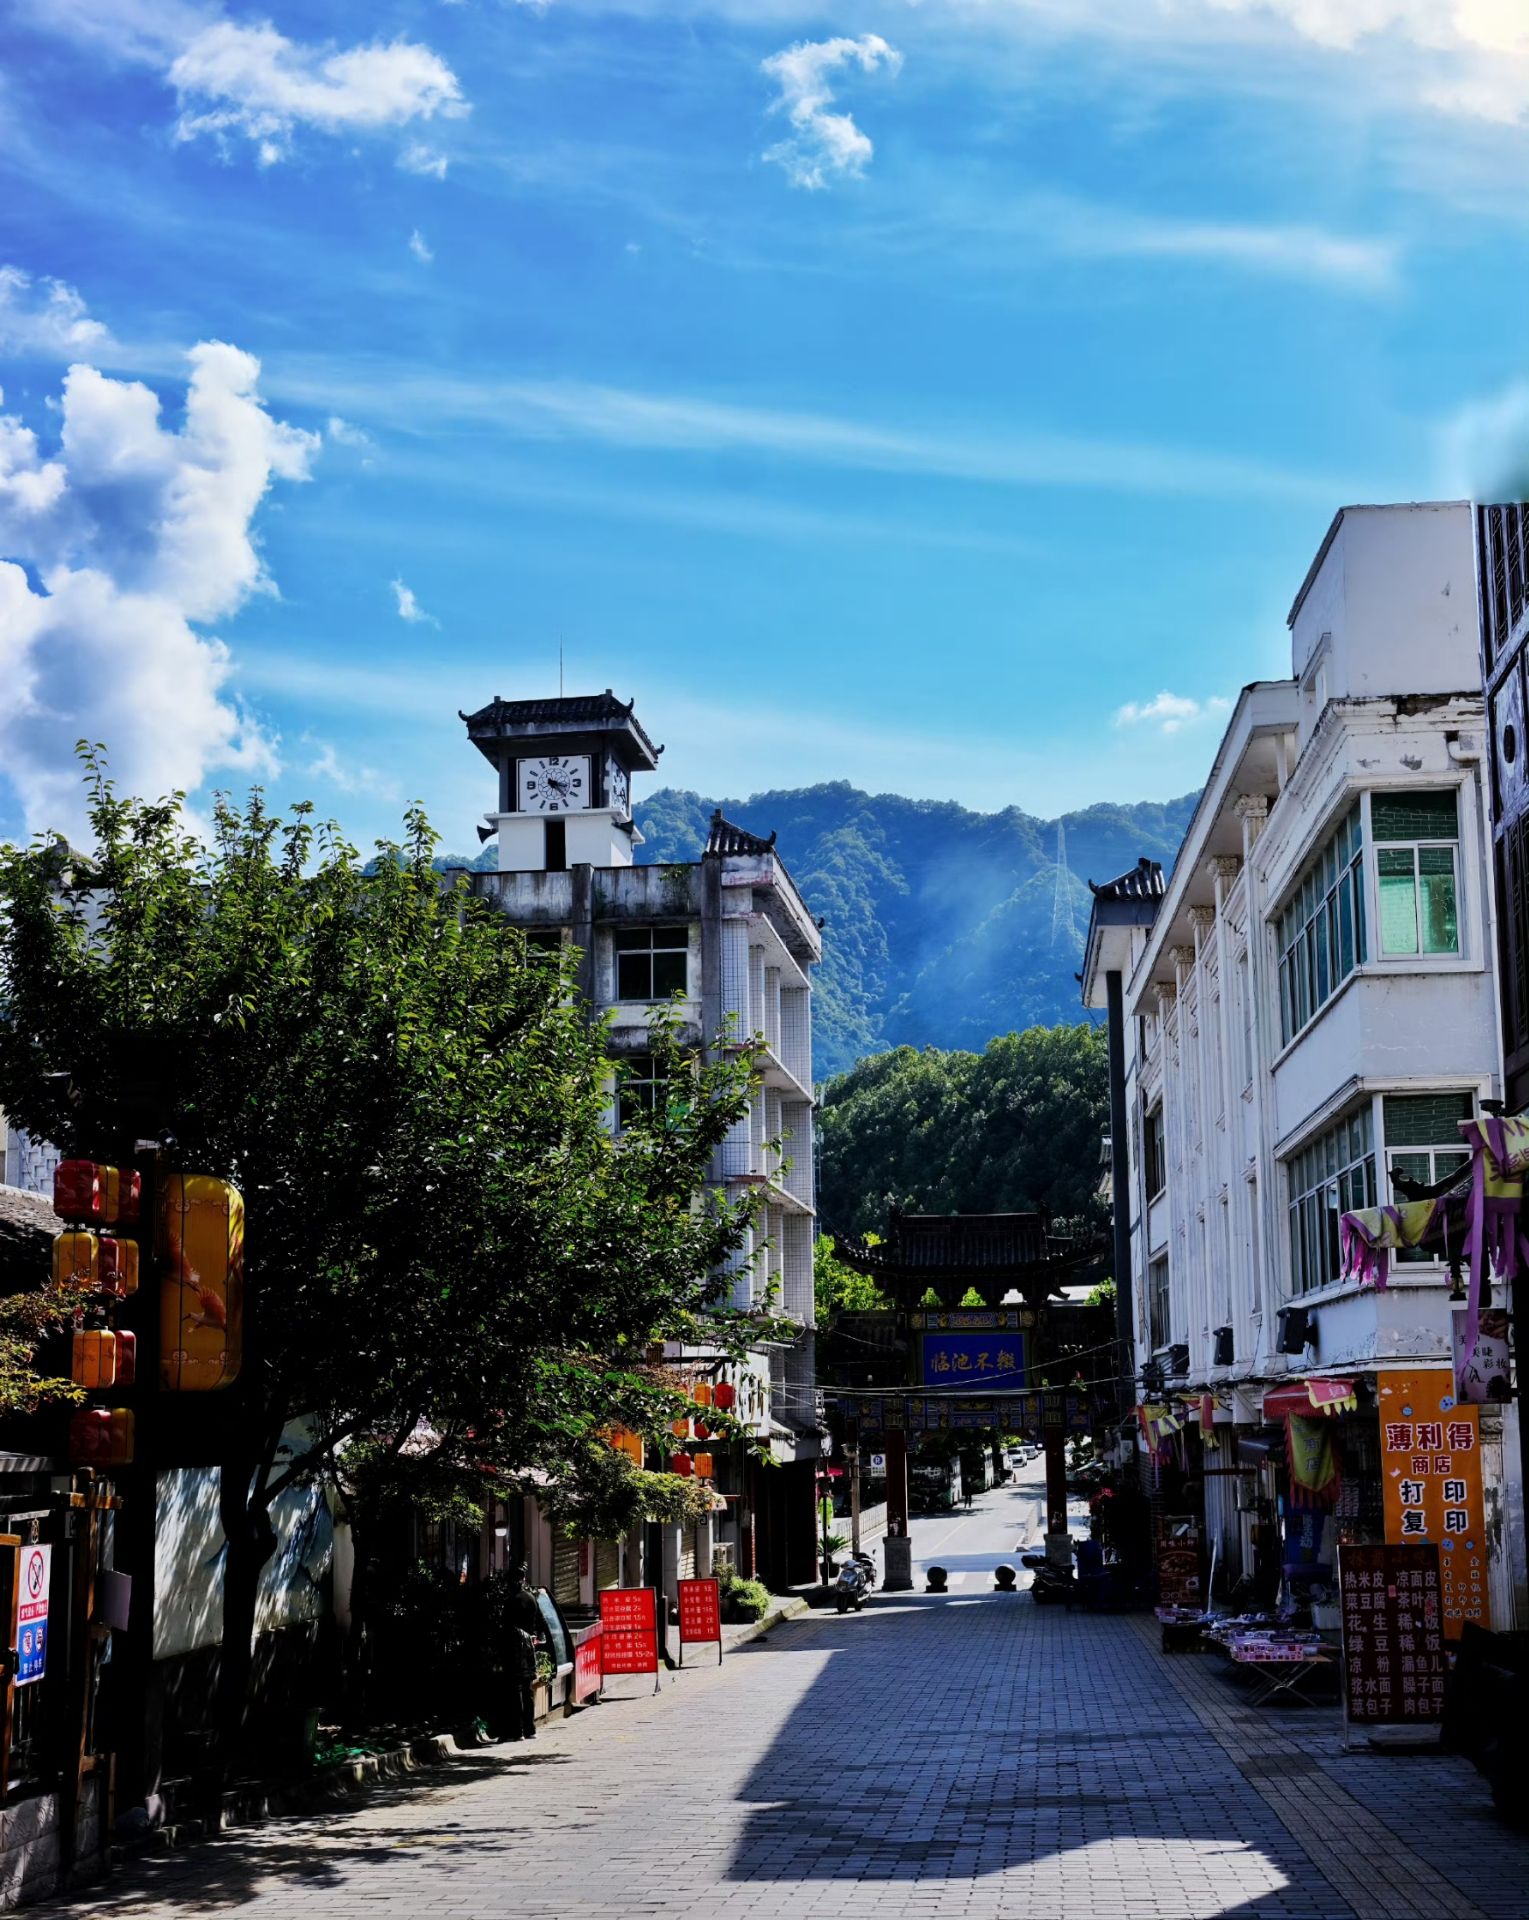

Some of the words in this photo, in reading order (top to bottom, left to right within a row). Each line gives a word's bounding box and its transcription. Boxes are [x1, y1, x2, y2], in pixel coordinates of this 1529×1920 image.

[549, 757, 560, 766] 12
[526, 780, 536, 790] 9
[572, 778, 581, 788] 3
[549, 802, 559, 811] 6
[1386, 1422, 1473, 1452] 薄利得
[1411, 1455, 1452, 1475] 商店
[1401, 1479, 1466, 1504] 打印
[1402, 1510, 1468, 1534] 复印
[1344, 1570, 1385, 1589] 热米皮
[1396, 1569, 1437, 1588] 凉面皮
[1345, 1592, 1386, 1610] 菜豆腐
[1397, 1591, 1439, 1610] 茶叶蛋
[1349, 1656, 1390, 1673] 凉粉
[1402, 1656, 1444, 1673] 漏鱼儿
[1351, 1677, 1392, 1695] 浆水面
[1352, 1698, 1393, 1716] 菜包子
[1404, 1697, 1445, 1716] 肉包子
